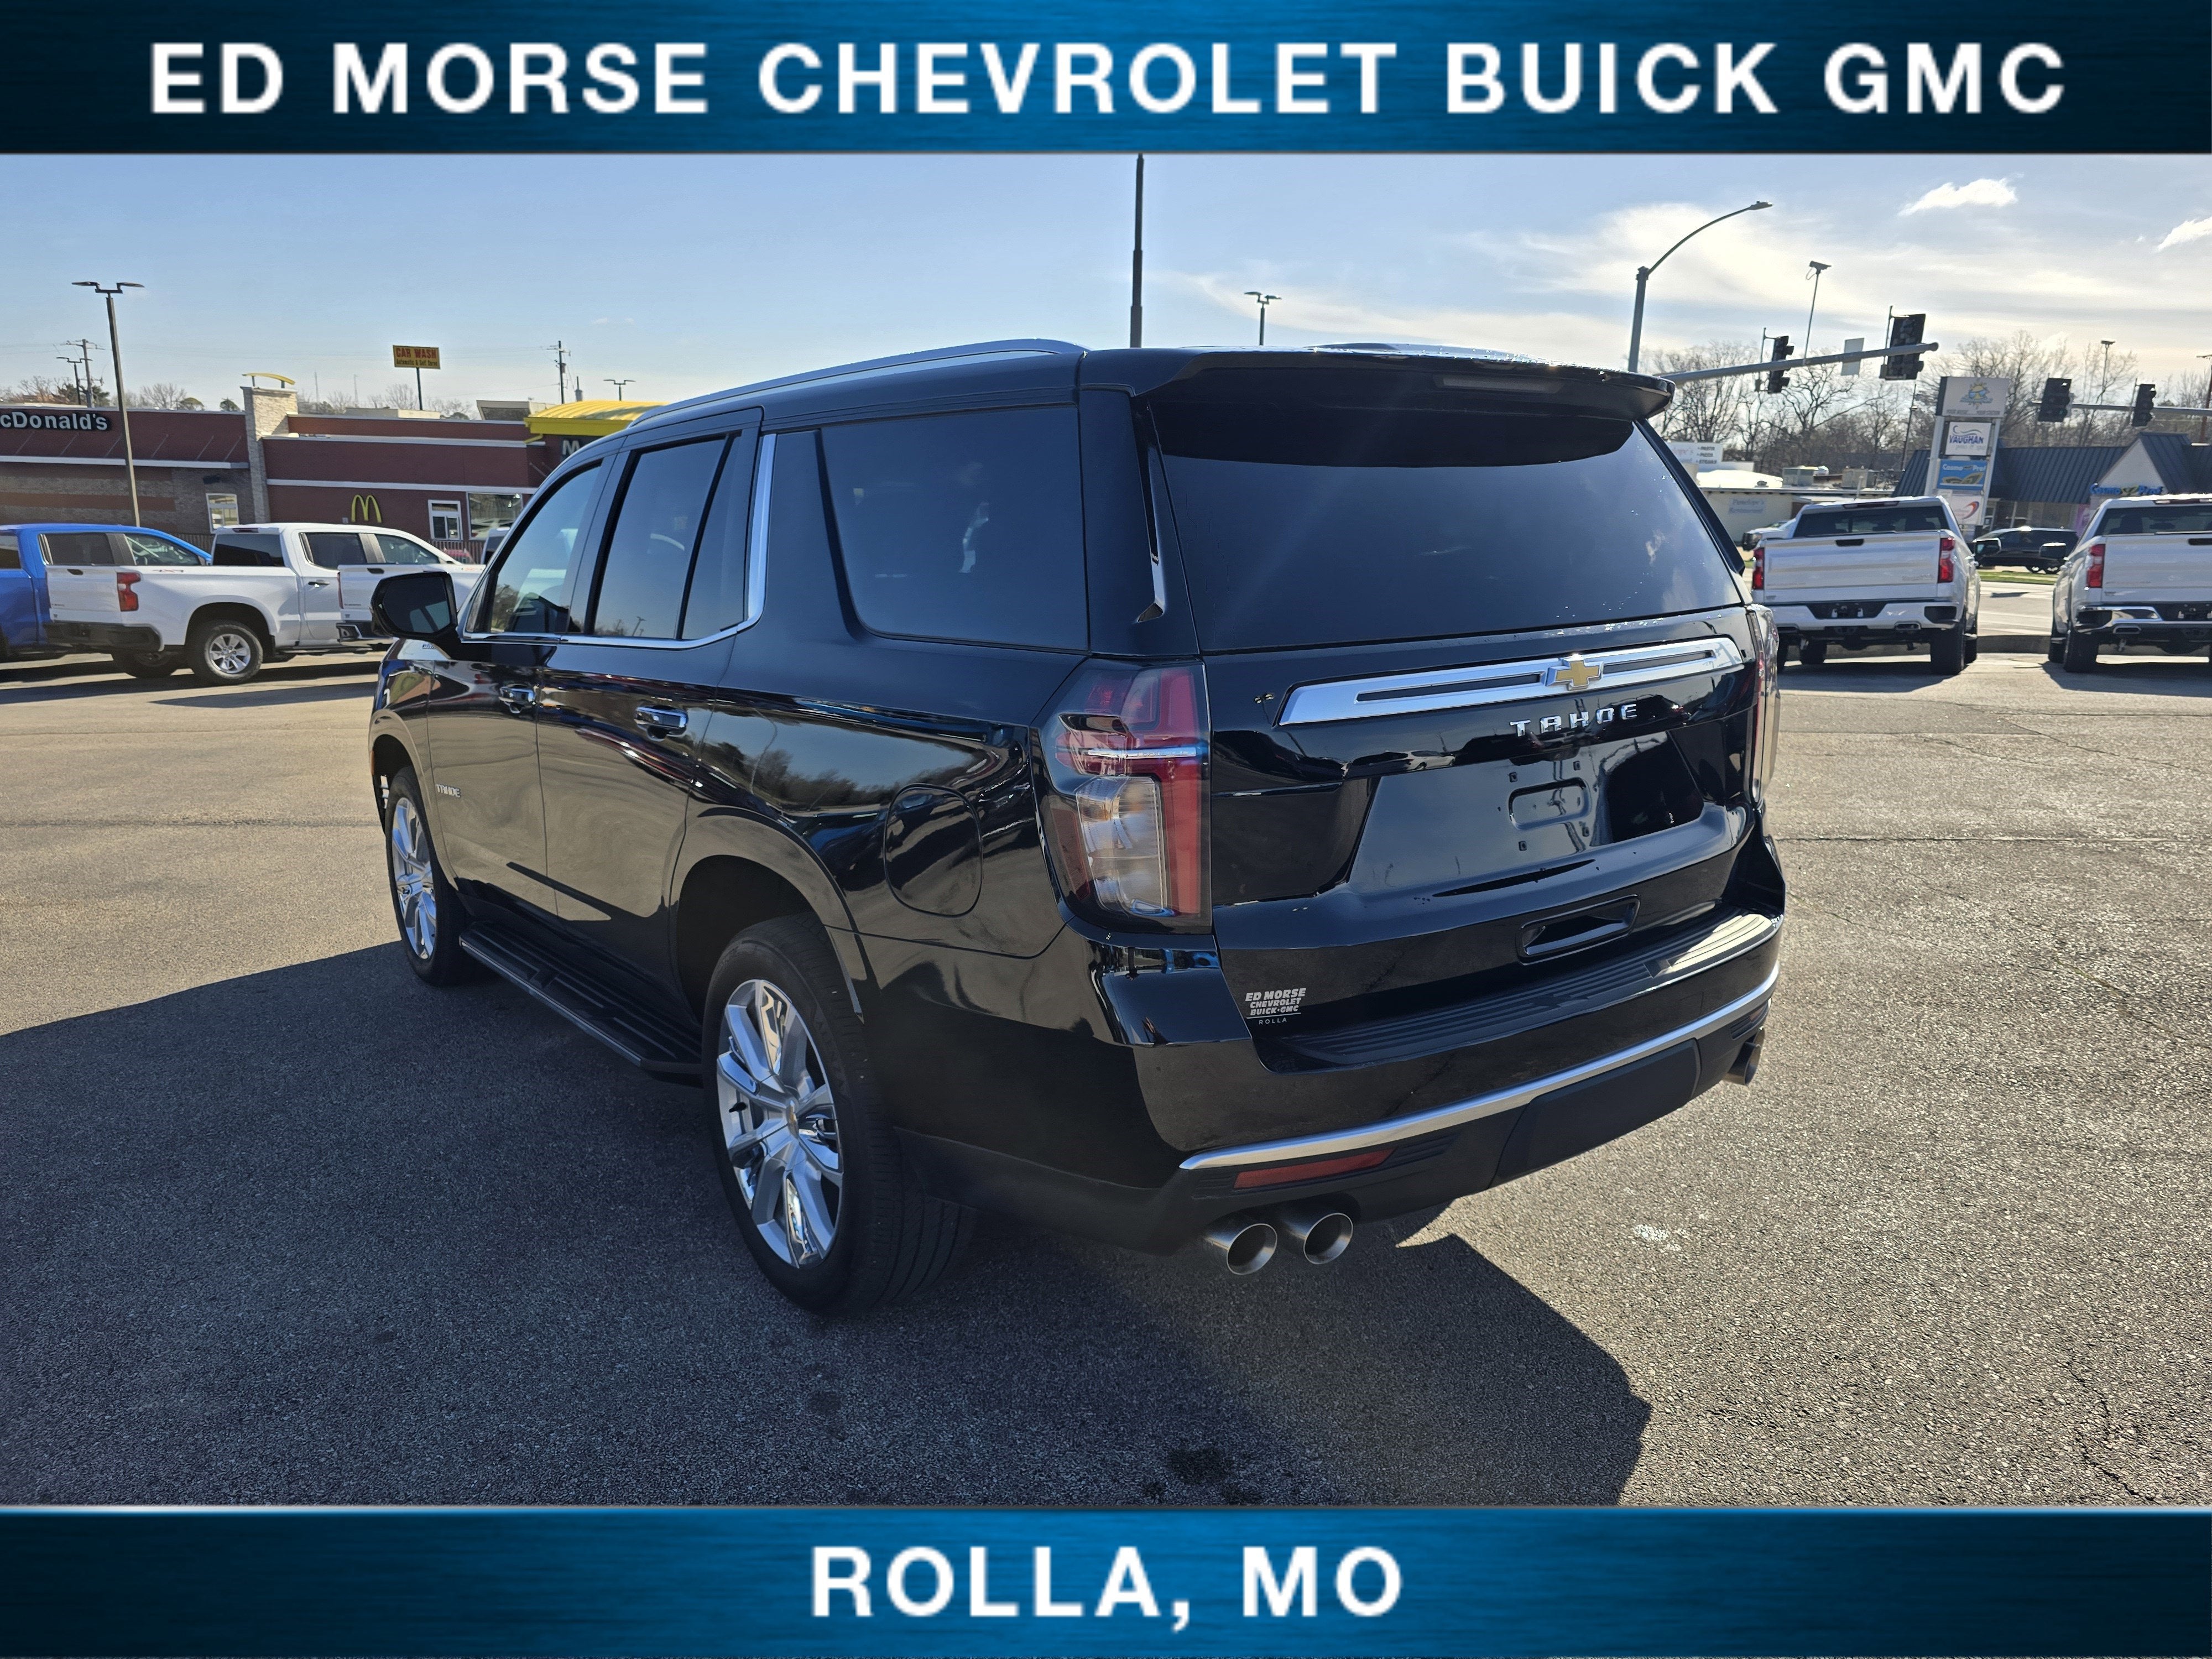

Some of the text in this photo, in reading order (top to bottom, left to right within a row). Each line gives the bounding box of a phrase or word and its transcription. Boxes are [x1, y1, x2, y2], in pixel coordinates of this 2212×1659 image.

[395, 347, 437, 359] CAR WASH
[0, 411, 108, 430] cDonald's
[1949, 435, 1984, 444] VAUGHAN
[2090, 482, 2163, 495] Cosmo Prof
[1509, 703, 1638, 737] TAHOE
[436, 783, 461, 798] TAHOE
[1245, 988, 1306, 1001] ED MORSE
[1250, 997, 1302, 1009] CHEVROLET
[1258, 1017, 1287, 1025] ROLLA
